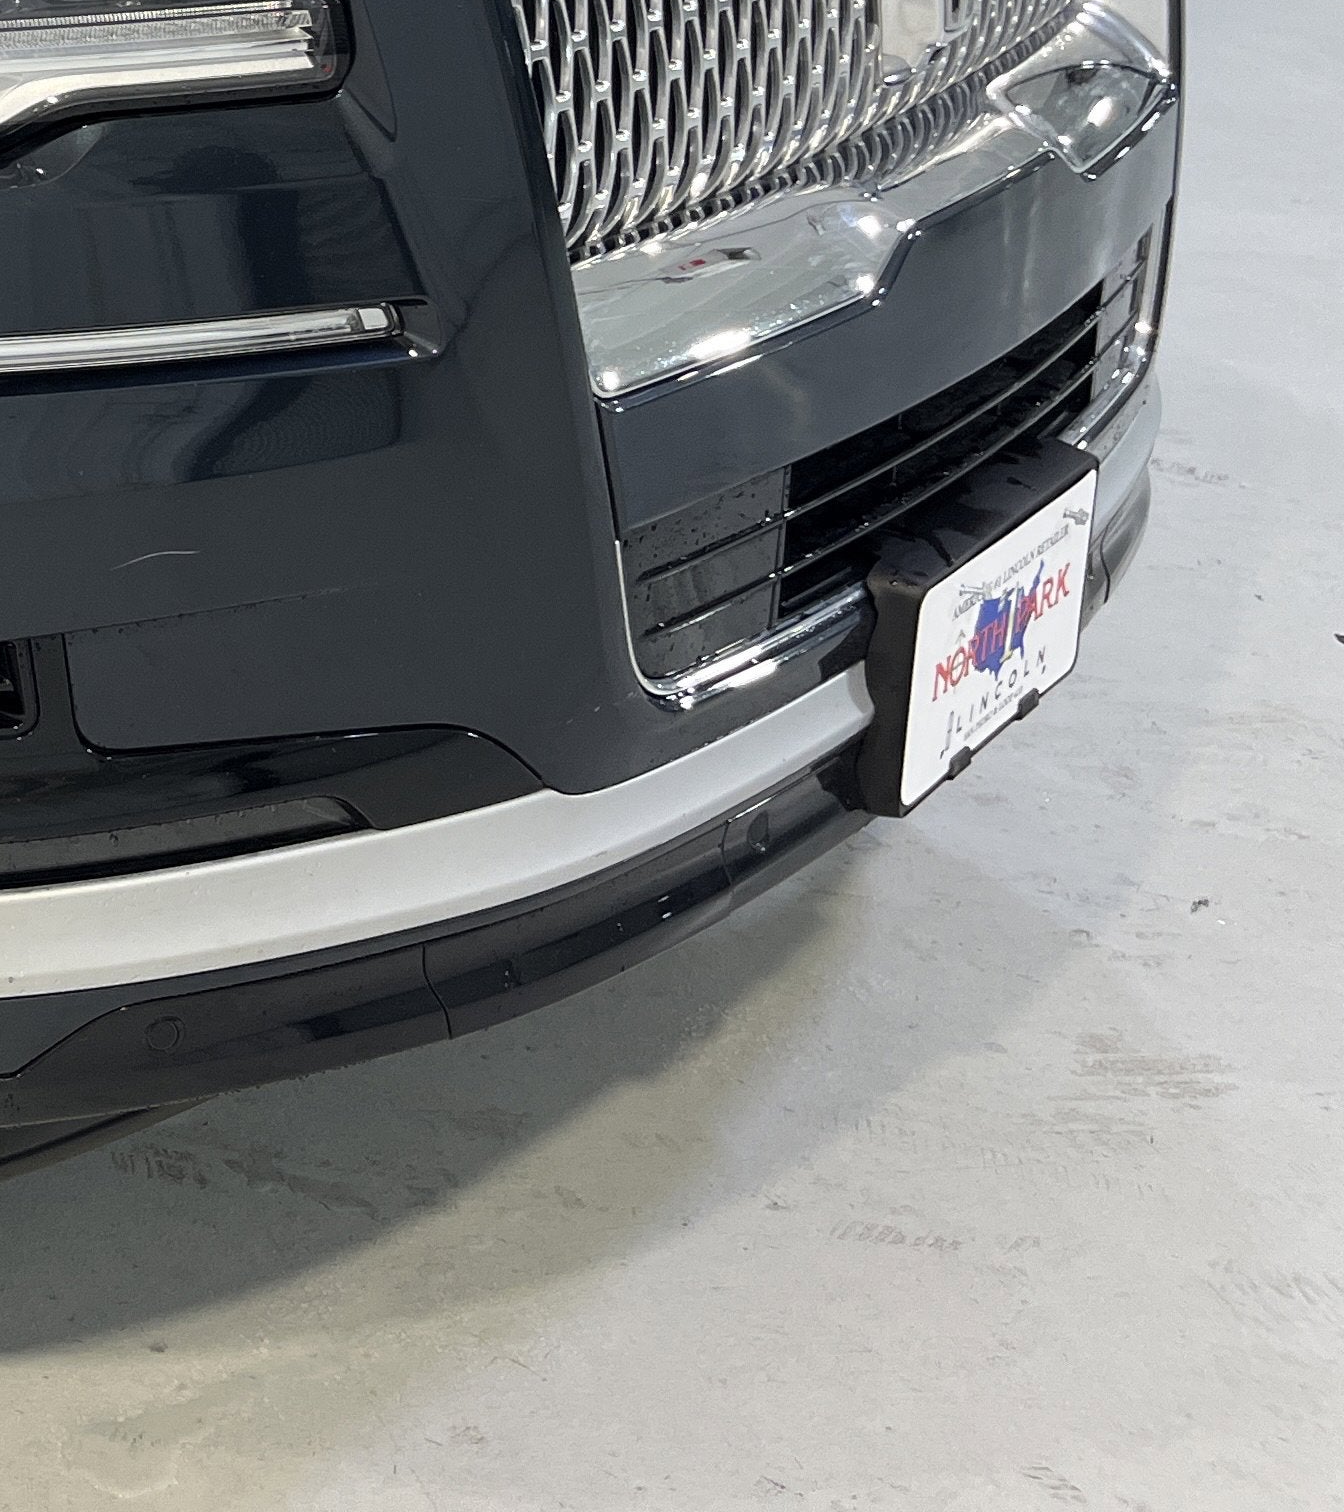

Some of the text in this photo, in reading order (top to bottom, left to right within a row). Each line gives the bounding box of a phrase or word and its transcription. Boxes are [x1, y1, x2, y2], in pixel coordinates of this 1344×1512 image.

[932, 562, 1070, 702] NORTH PARK
[955, 645, 1046, 733] LINCOLN
